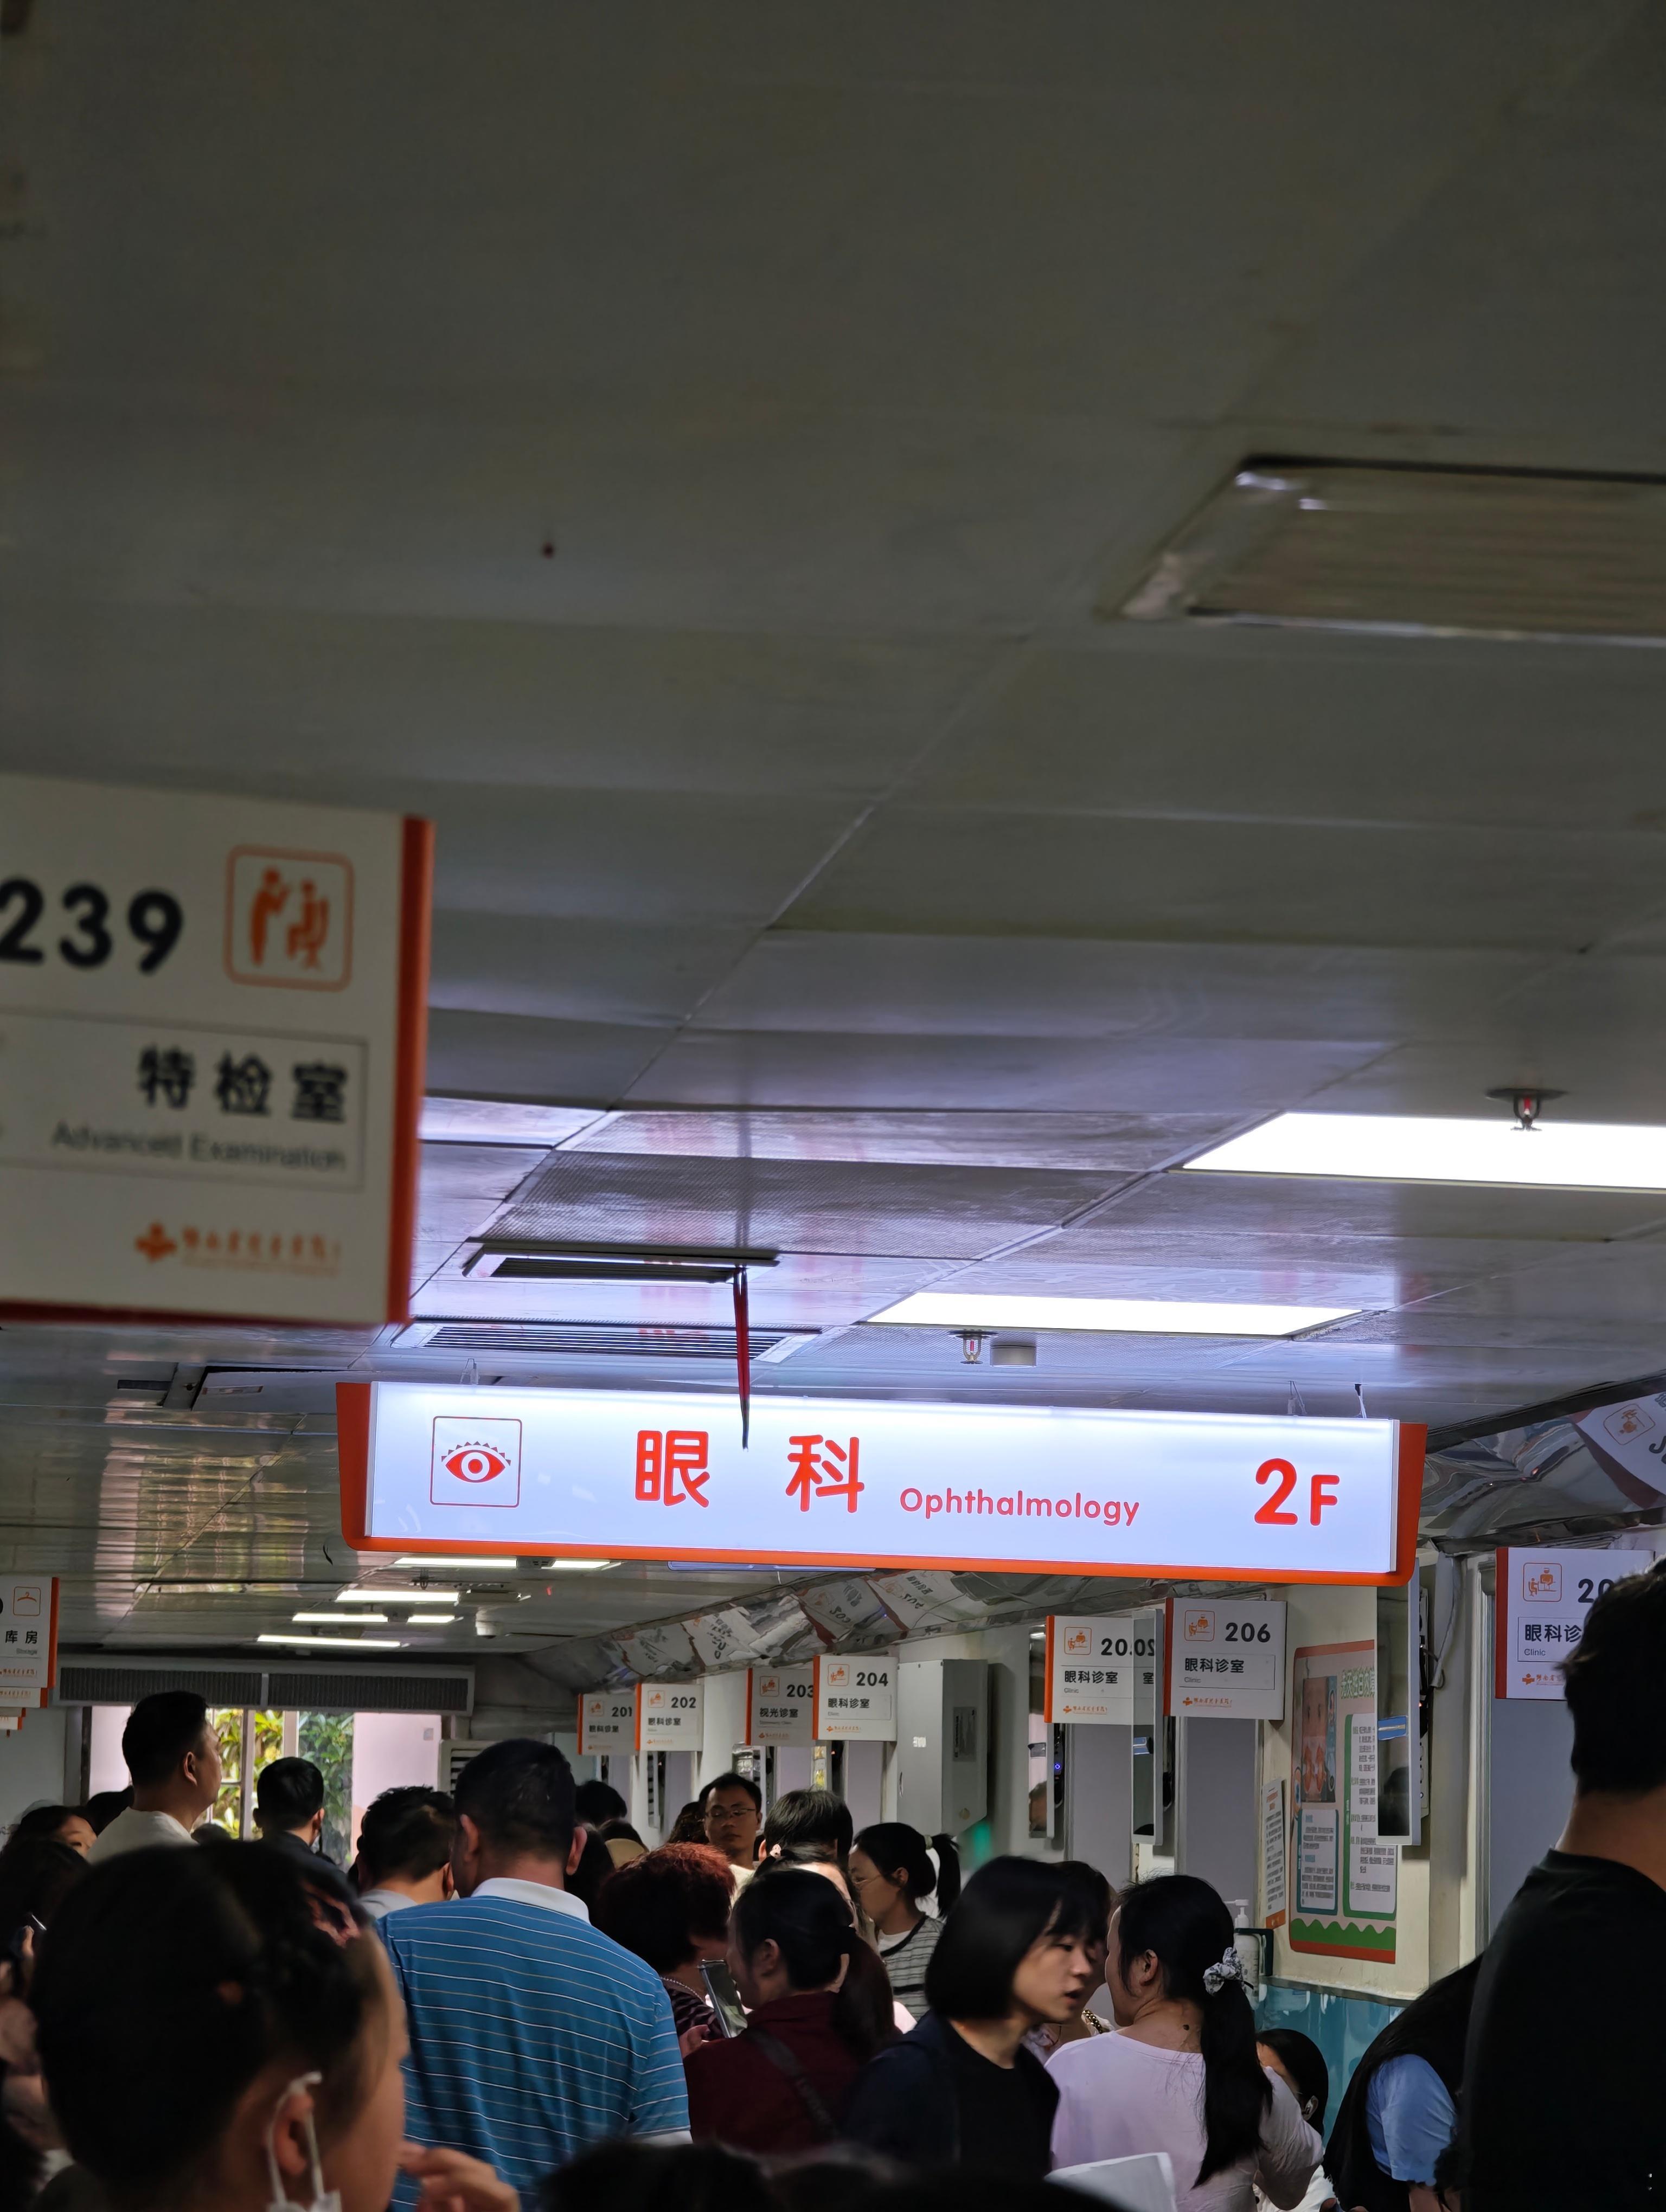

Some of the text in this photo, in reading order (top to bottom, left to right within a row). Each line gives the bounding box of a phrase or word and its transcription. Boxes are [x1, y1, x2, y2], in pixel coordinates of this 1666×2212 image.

[0, 879, 183, 974] 239
[138, 1046, 348, 1122] 特检室
[52, 1122, 346, 1172] Advanced Examination
[635, 1430, 865, 1513] 眼科
[1254, 1458, 1340, 1526] 2F
[900, 1487, 1139, 1526] Ophthalmology
[5, 1630, 38, 1644] 库房
[1225, 1622, 1271, 1643] 206
[1524, 1624, 1582, 1643] 眼科诊
[1101, 1638, 1132, 1656] 20
[1524, 1648, 1546, 1656] Clinic
[1185, 1658, 1245, 1673] 眼科诊室
[856, 1672, 888, 1687] 204
[1065, 1670, 1118, 1684] 眼科诊室
[786, 1684, 813, 1697] 203
[671, 1696, 696, 1708] 202
[828, 1698, 870, 1708] 眼科诊室
[611, 1706, 632, 1717] 201
[759, 1707, 798, 1718] 视光诊室
[648, 1717, 681, 1726] 眼科诊室
